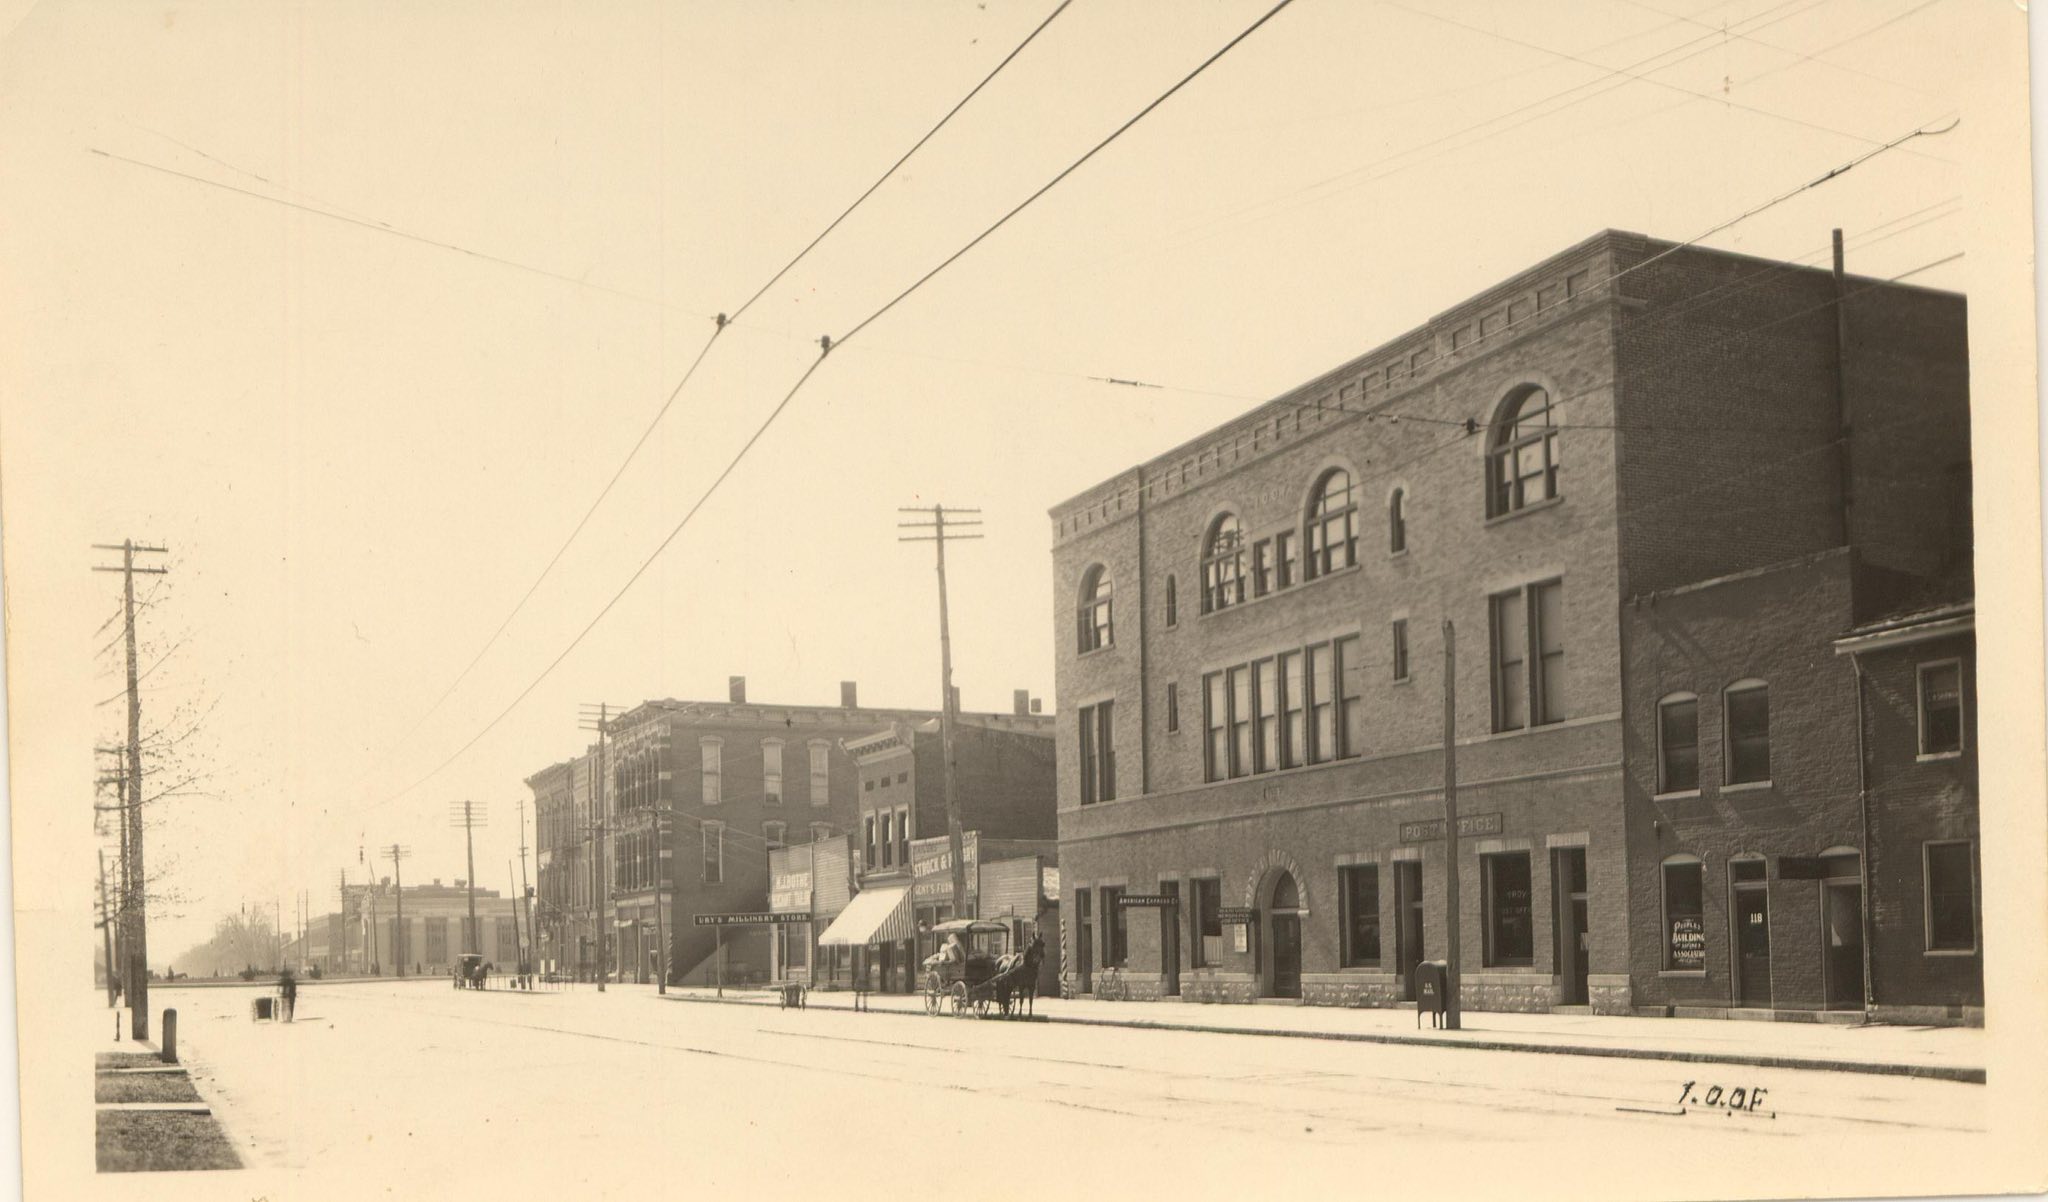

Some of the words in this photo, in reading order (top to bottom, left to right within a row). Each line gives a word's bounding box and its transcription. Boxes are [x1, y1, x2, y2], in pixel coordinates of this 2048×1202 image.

[1405, 823, 1438, 839] POST
[1119, 896, 1146, 905] AMERICAN
[728, 914, 774, 923] MILLINERY
[1672, 932, 1705, 944] BUILDING
